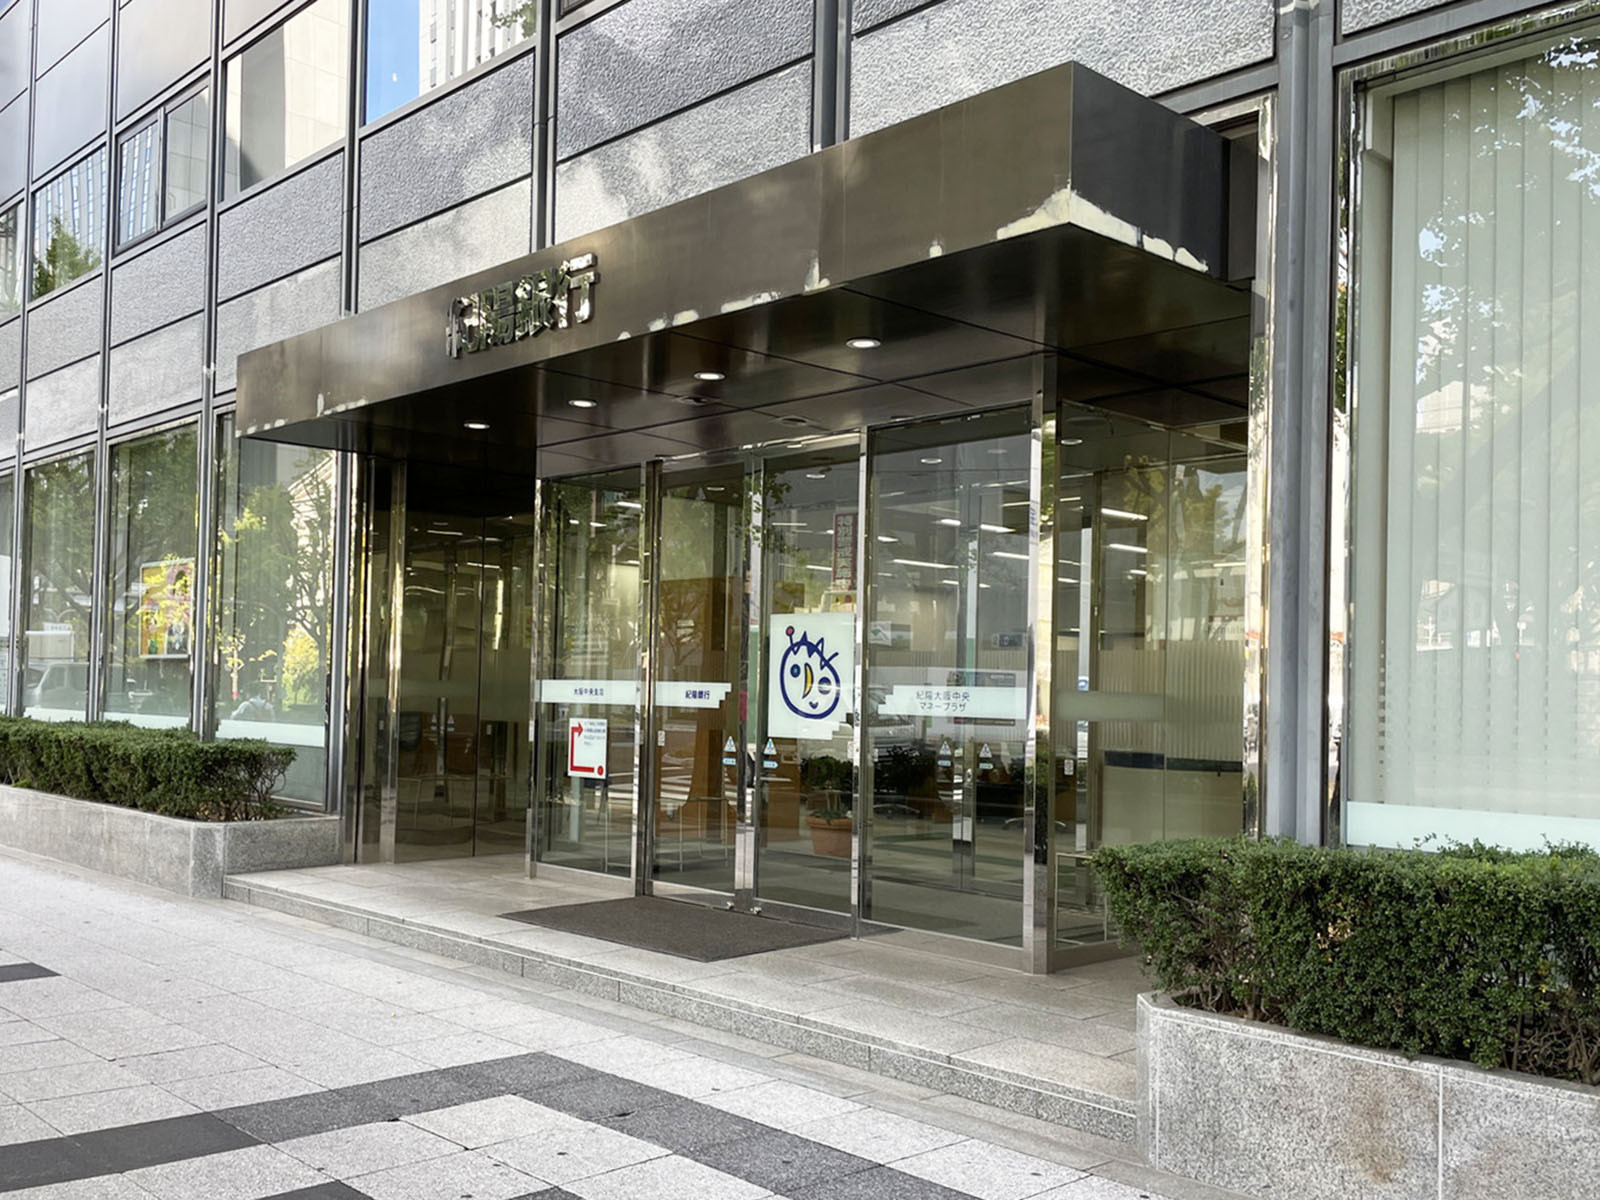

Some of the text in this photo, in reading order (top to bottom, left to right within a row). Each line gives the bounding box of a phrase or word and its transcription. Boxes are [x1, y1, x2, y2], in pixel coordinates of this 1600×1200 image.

[446, 253, 598, 358] 紀陽銀行
[685, 689, 711, 700] 紀陽銀行
[916, 690, 970, 702] 紀陽大阪中央
[919, 702, 967, 712] マネープラザ
